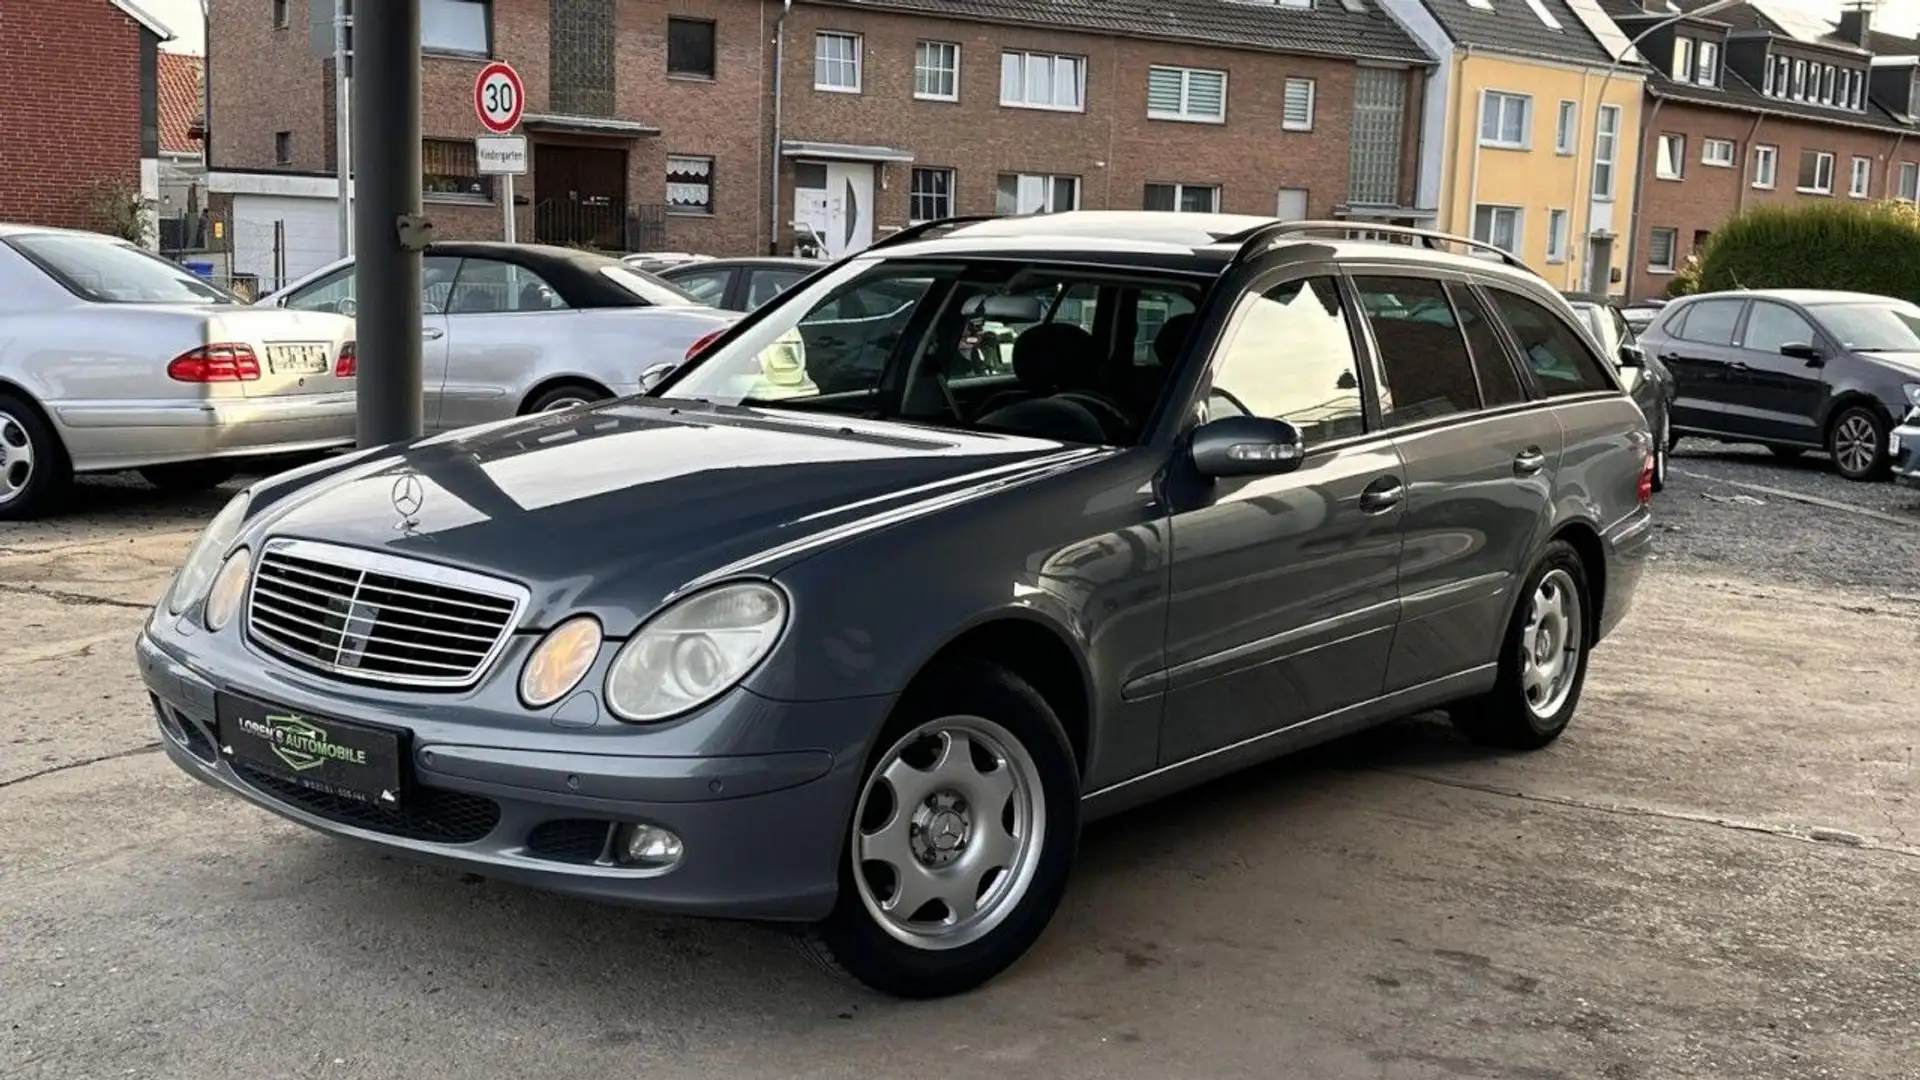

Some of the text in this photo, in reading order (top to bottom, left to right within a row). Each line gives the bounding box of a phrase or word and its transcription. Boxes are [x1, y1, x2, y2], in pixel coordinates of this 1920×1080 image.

[486, 83, 512, 112] 30
[480, 149, 522, 163] Kindergarten
[286, 733, 366, 764] AUTOMOBILE
